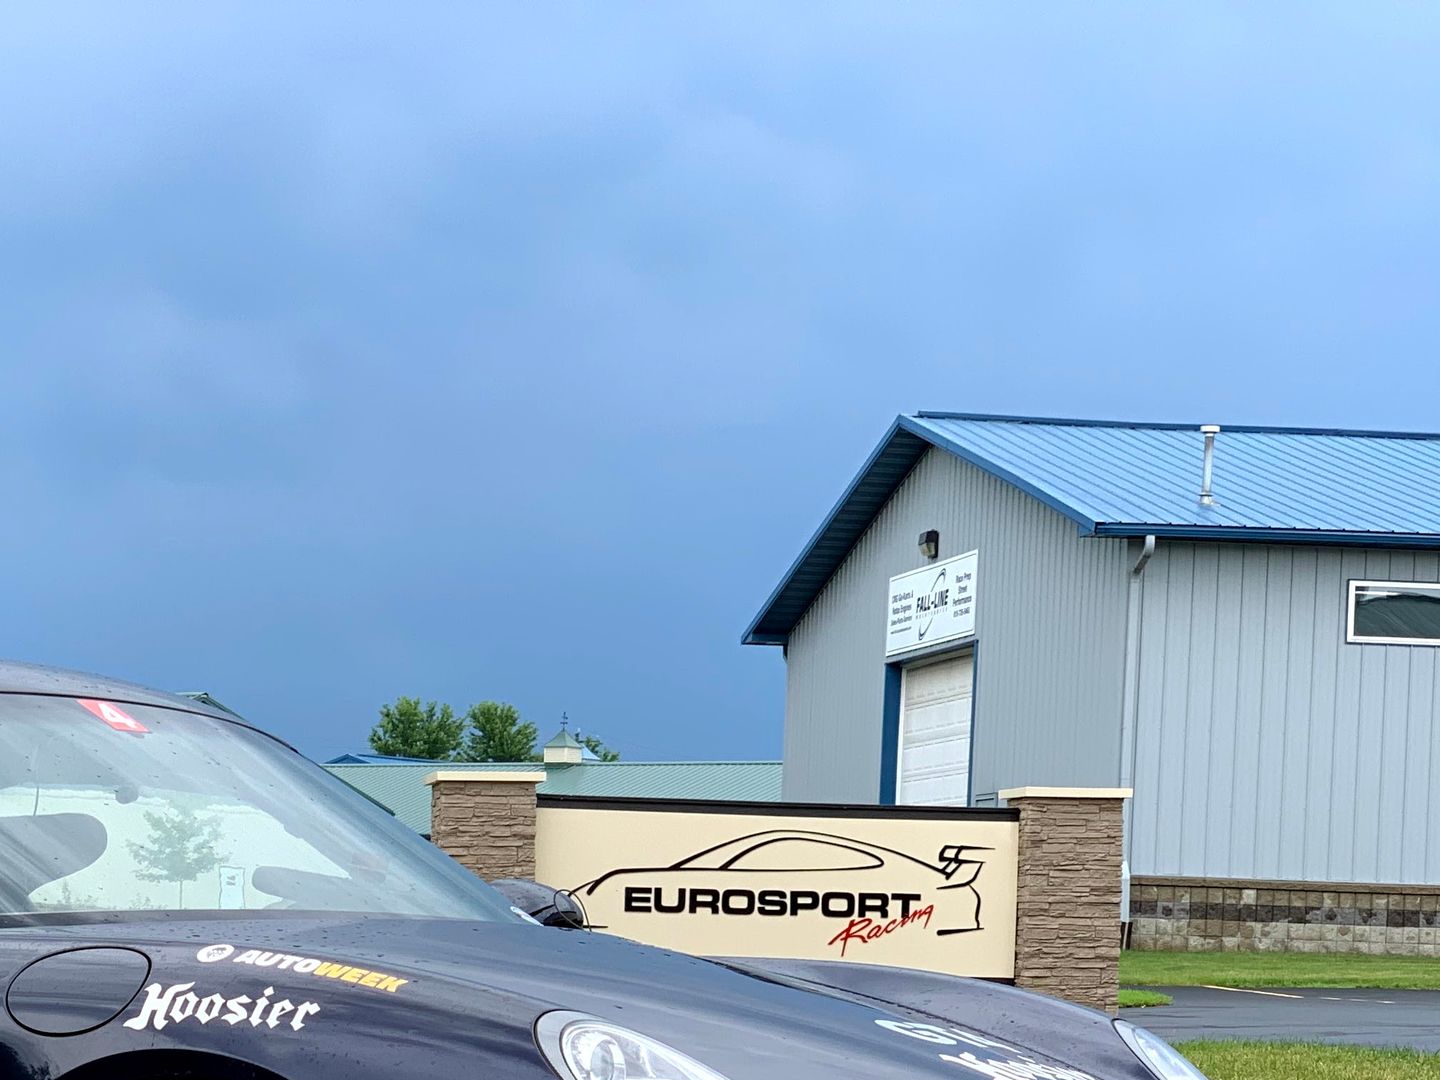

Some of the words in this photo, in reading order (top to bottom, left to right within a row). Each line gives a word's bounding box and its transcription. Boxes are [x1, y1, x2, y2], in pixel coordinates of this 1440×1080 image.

[916, 588, 949, 613] FALL-LINE
[624, 886, 921, 919] EUROSPORT
[827, 903, 935, 957] Racing
[233, 949, 408, 993] AUTOWEEK
[122, 981, 321, 1031] Hoosier
